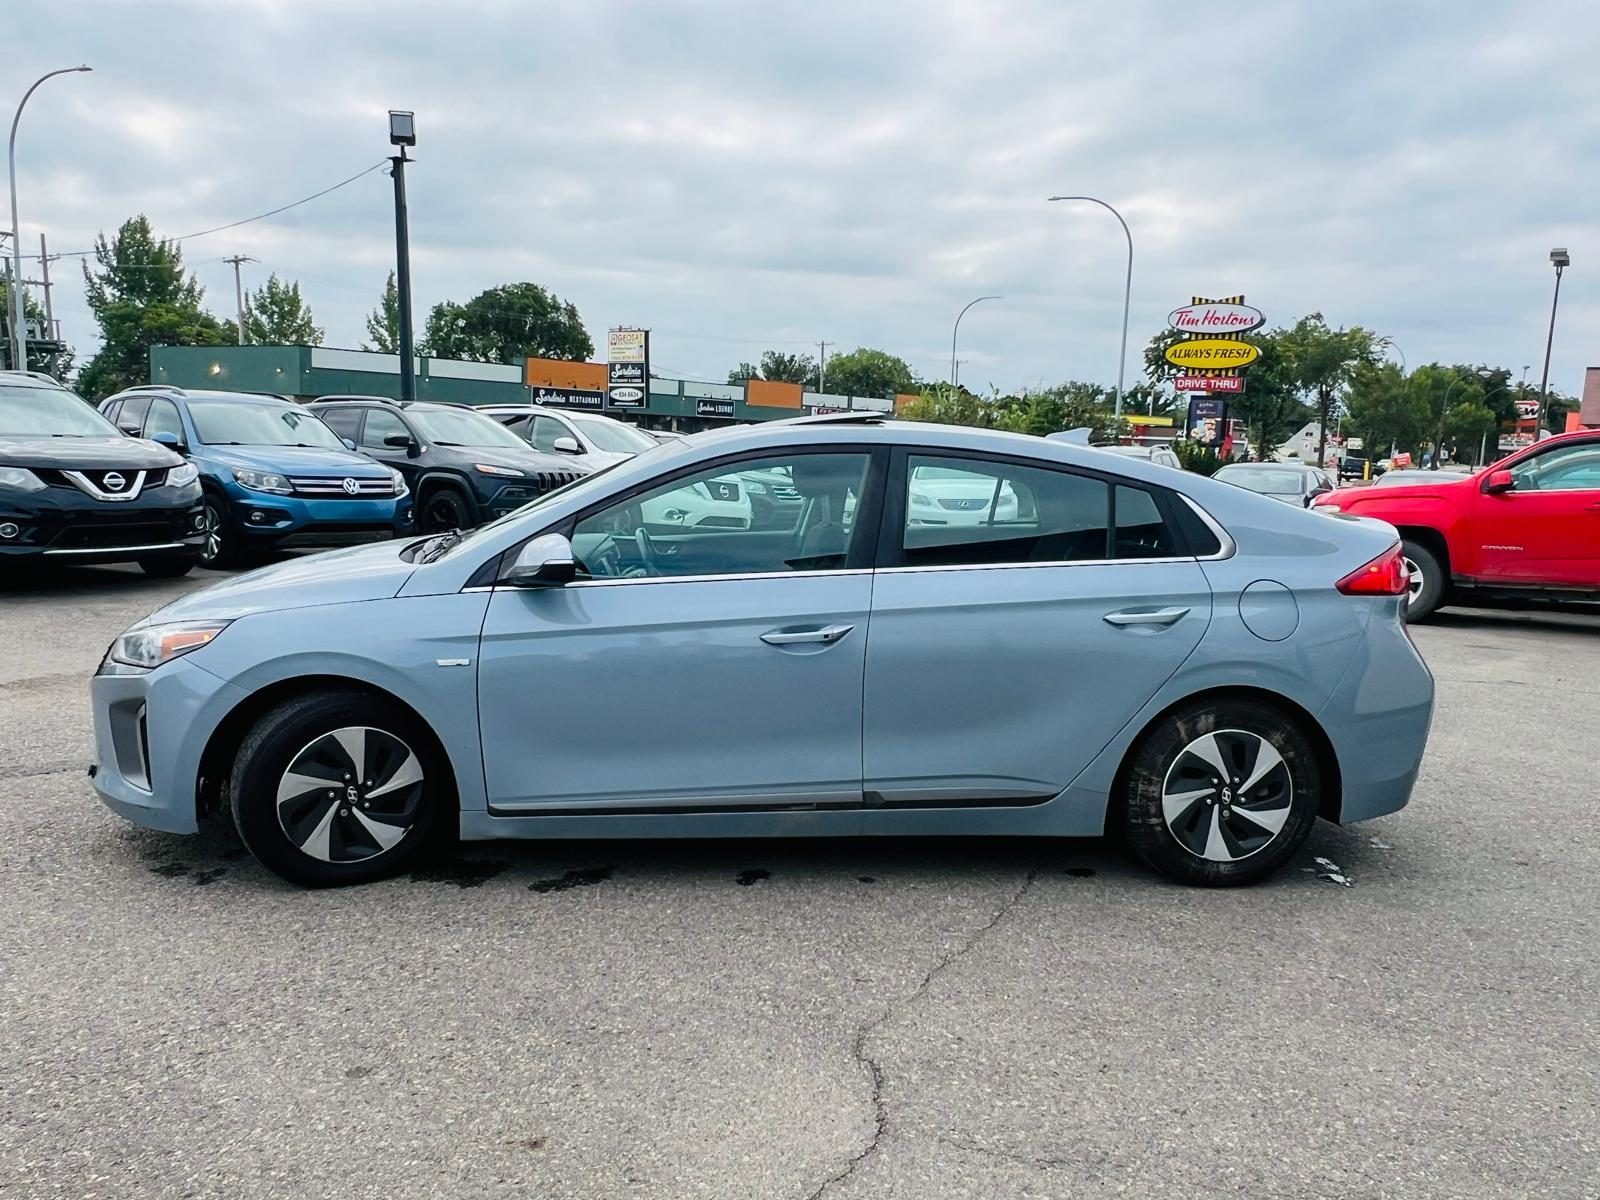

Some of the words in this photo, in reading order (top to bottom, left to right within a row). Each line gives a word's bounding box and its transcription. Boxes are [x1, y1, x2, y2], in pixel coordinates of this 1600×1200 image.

[1175, 310, 1199, 326] Tim
[1201, 310, 1254, 326] Hortons
[1170, 349, 1212, 359] ALWAYS
[1213, 349, 1252, 359] FRESH
[1177, 380, 1207, 388] DRIVE
[1210, 380, 1238, 389] THRU
[535, 389, 566, 404] Sardinia
[569, 395, 601, 404] RESTAURANT
